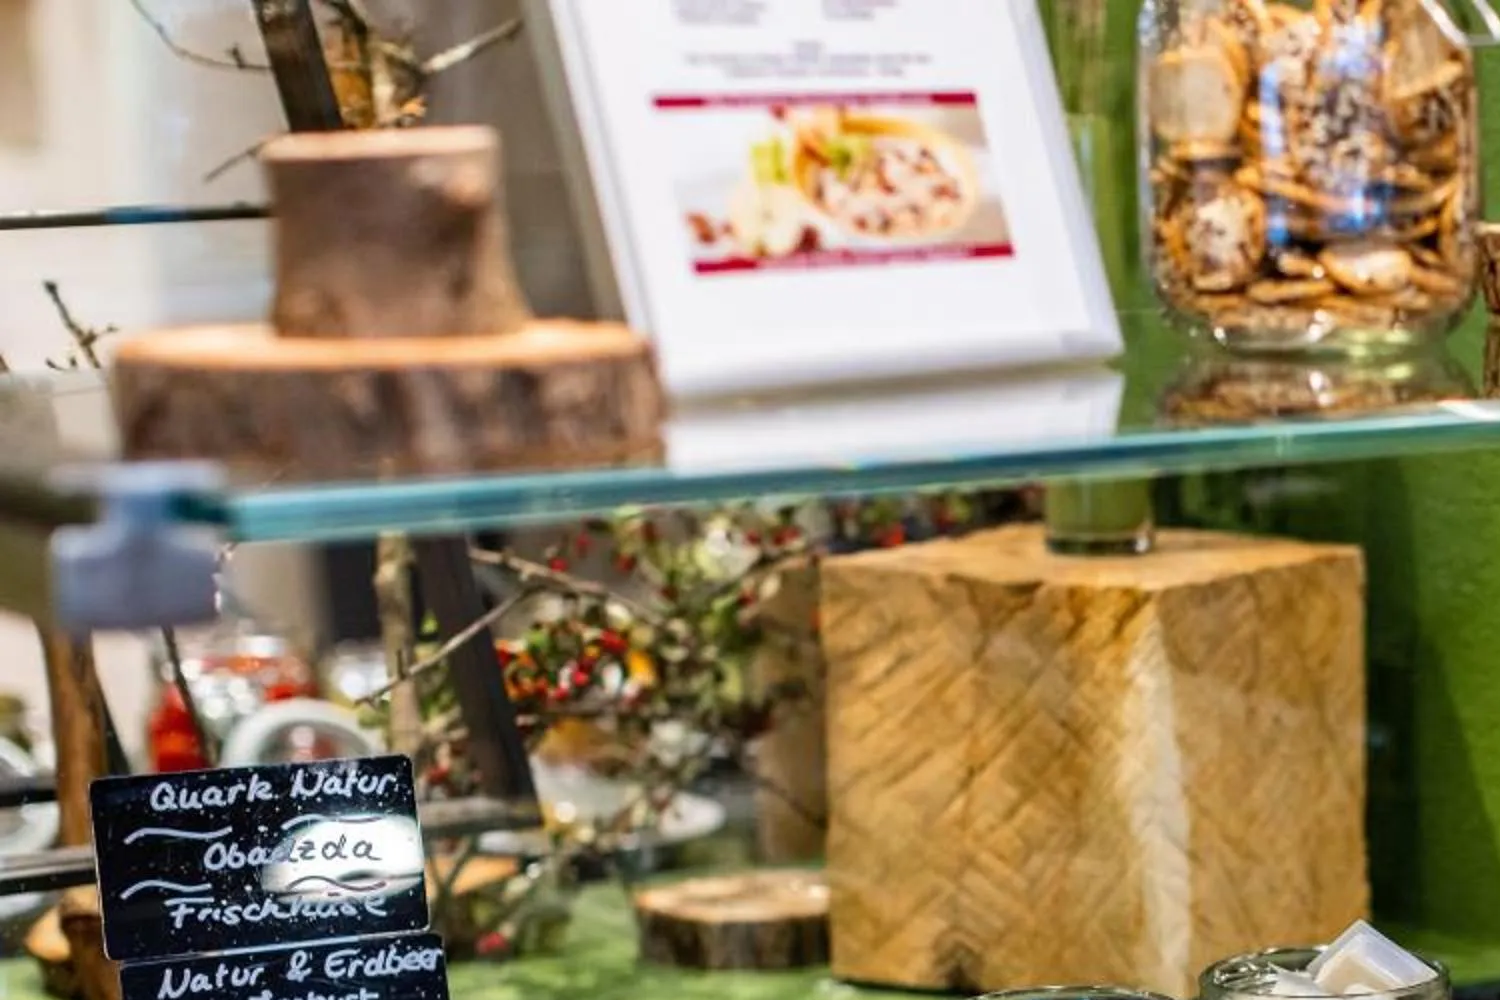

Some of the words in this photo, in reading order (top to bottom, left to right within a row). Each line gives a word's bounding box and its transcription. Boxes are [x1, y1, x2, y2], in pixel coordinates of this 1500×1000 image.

[150, 773, 273, 812] Quark
[290, 768, 397, 800] Natur
[156, 964, 264, 1000] Natur
[286, 950, 312, 982] &
[324, 946, 443, 978] Erdbeer
